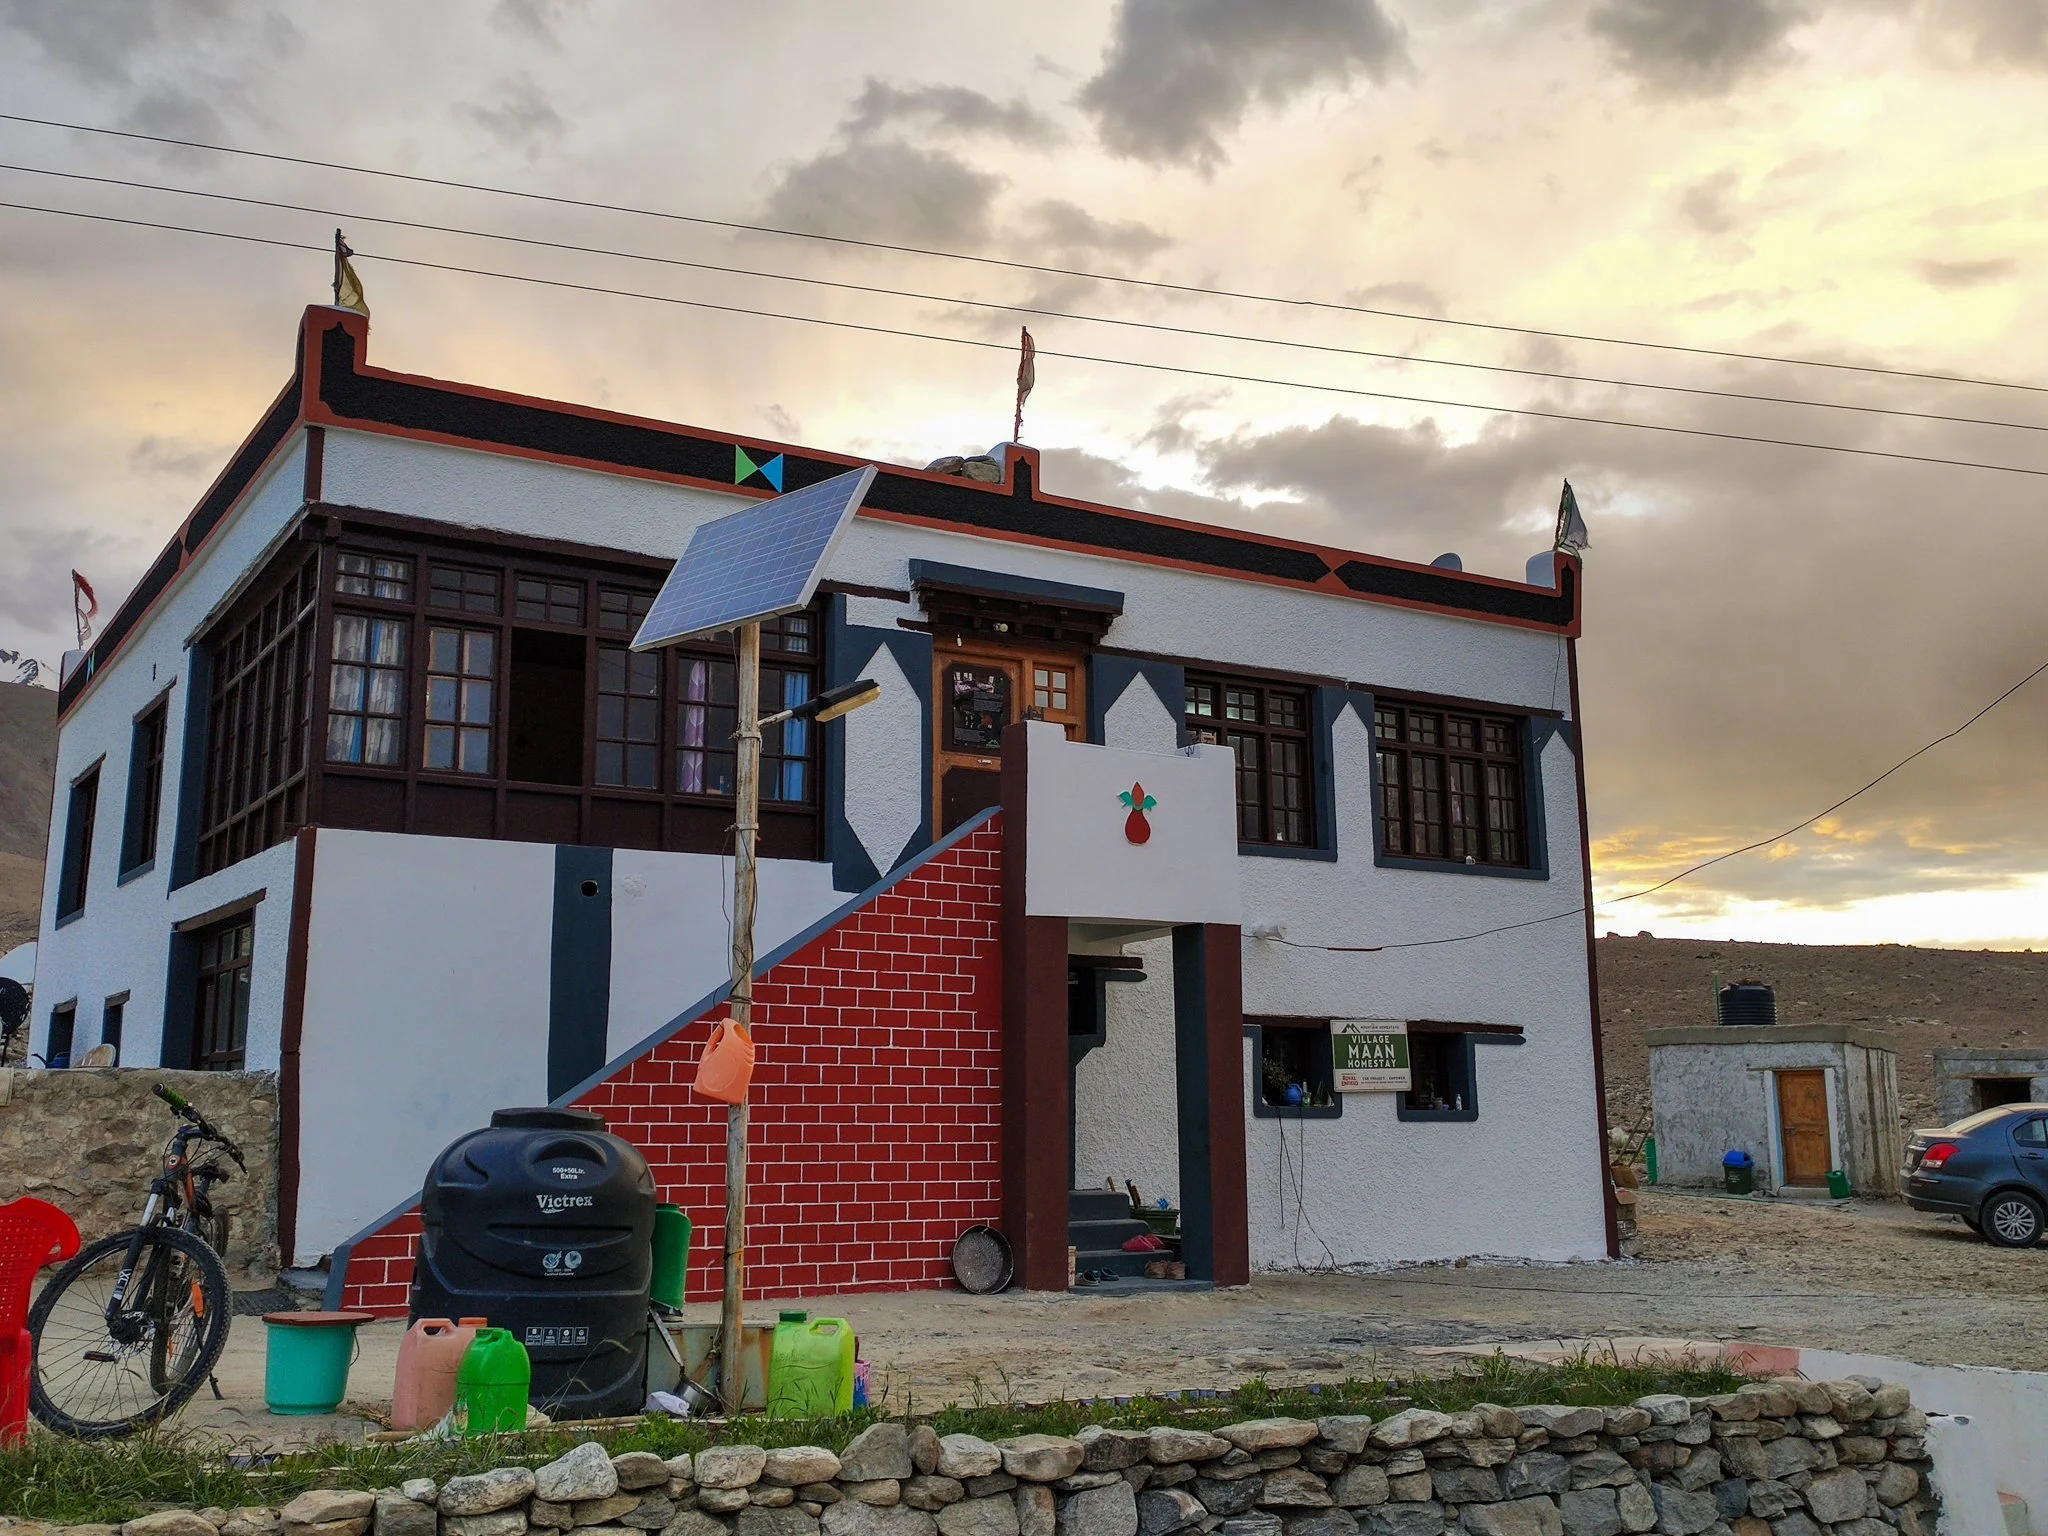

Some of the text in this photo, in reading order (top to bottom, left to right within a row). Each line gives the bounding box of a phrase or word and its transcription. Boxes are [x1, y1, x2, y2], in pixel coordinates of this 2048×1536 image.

[1351, 1035, 1390, 1043] VILLAGE
[1348, 1044, 1395, 1059] MAAN
[1347, 1059, 1397, 1068] HOMESTAY
[536, 1194, 593, 1208] Victrex
